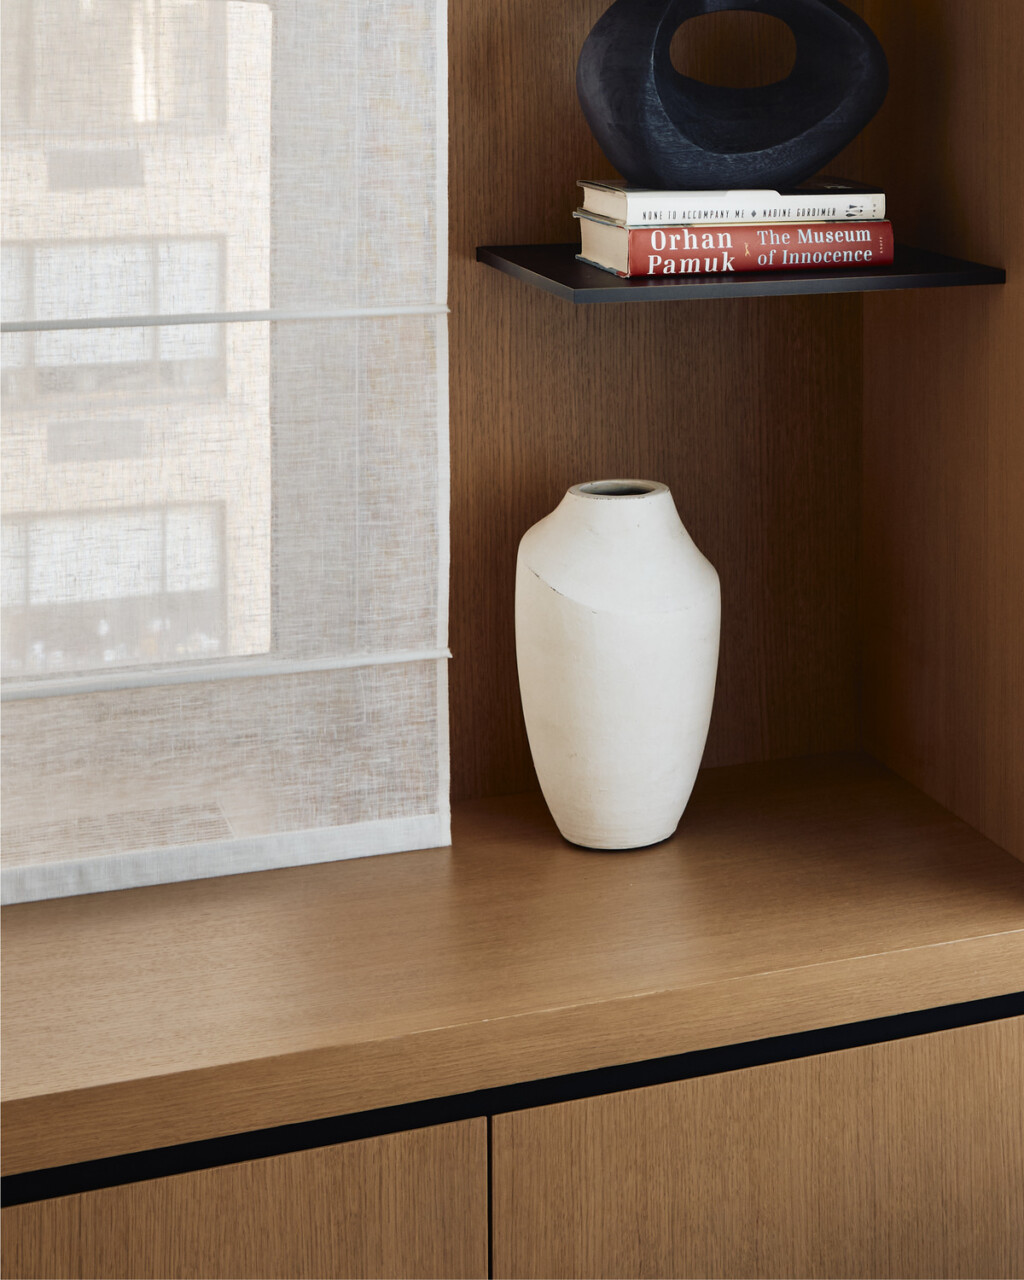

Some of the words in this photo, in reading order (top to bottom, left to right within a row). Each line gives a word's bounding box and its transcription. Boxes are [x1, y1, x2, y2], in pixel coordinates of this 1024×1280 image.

[642, 210, 663, 220] NONE
[668, 210, 677, 220] TO
[682, 210, 730, 219] ACCOMPANY
[734, 209, 745, 218] ME
[762, 208, 791, 218] NADINE
[796, 207, 836, 217] GORDIMER
[650, 228, 734, 251] Orhan
[756, 230, 790, 246] The
[797, 228, 872, 244] Museum
[646, 251, 736, 275] Pamuk
[757, 249, 776, 266] of
[782, 249, 873, 264] Innocence
